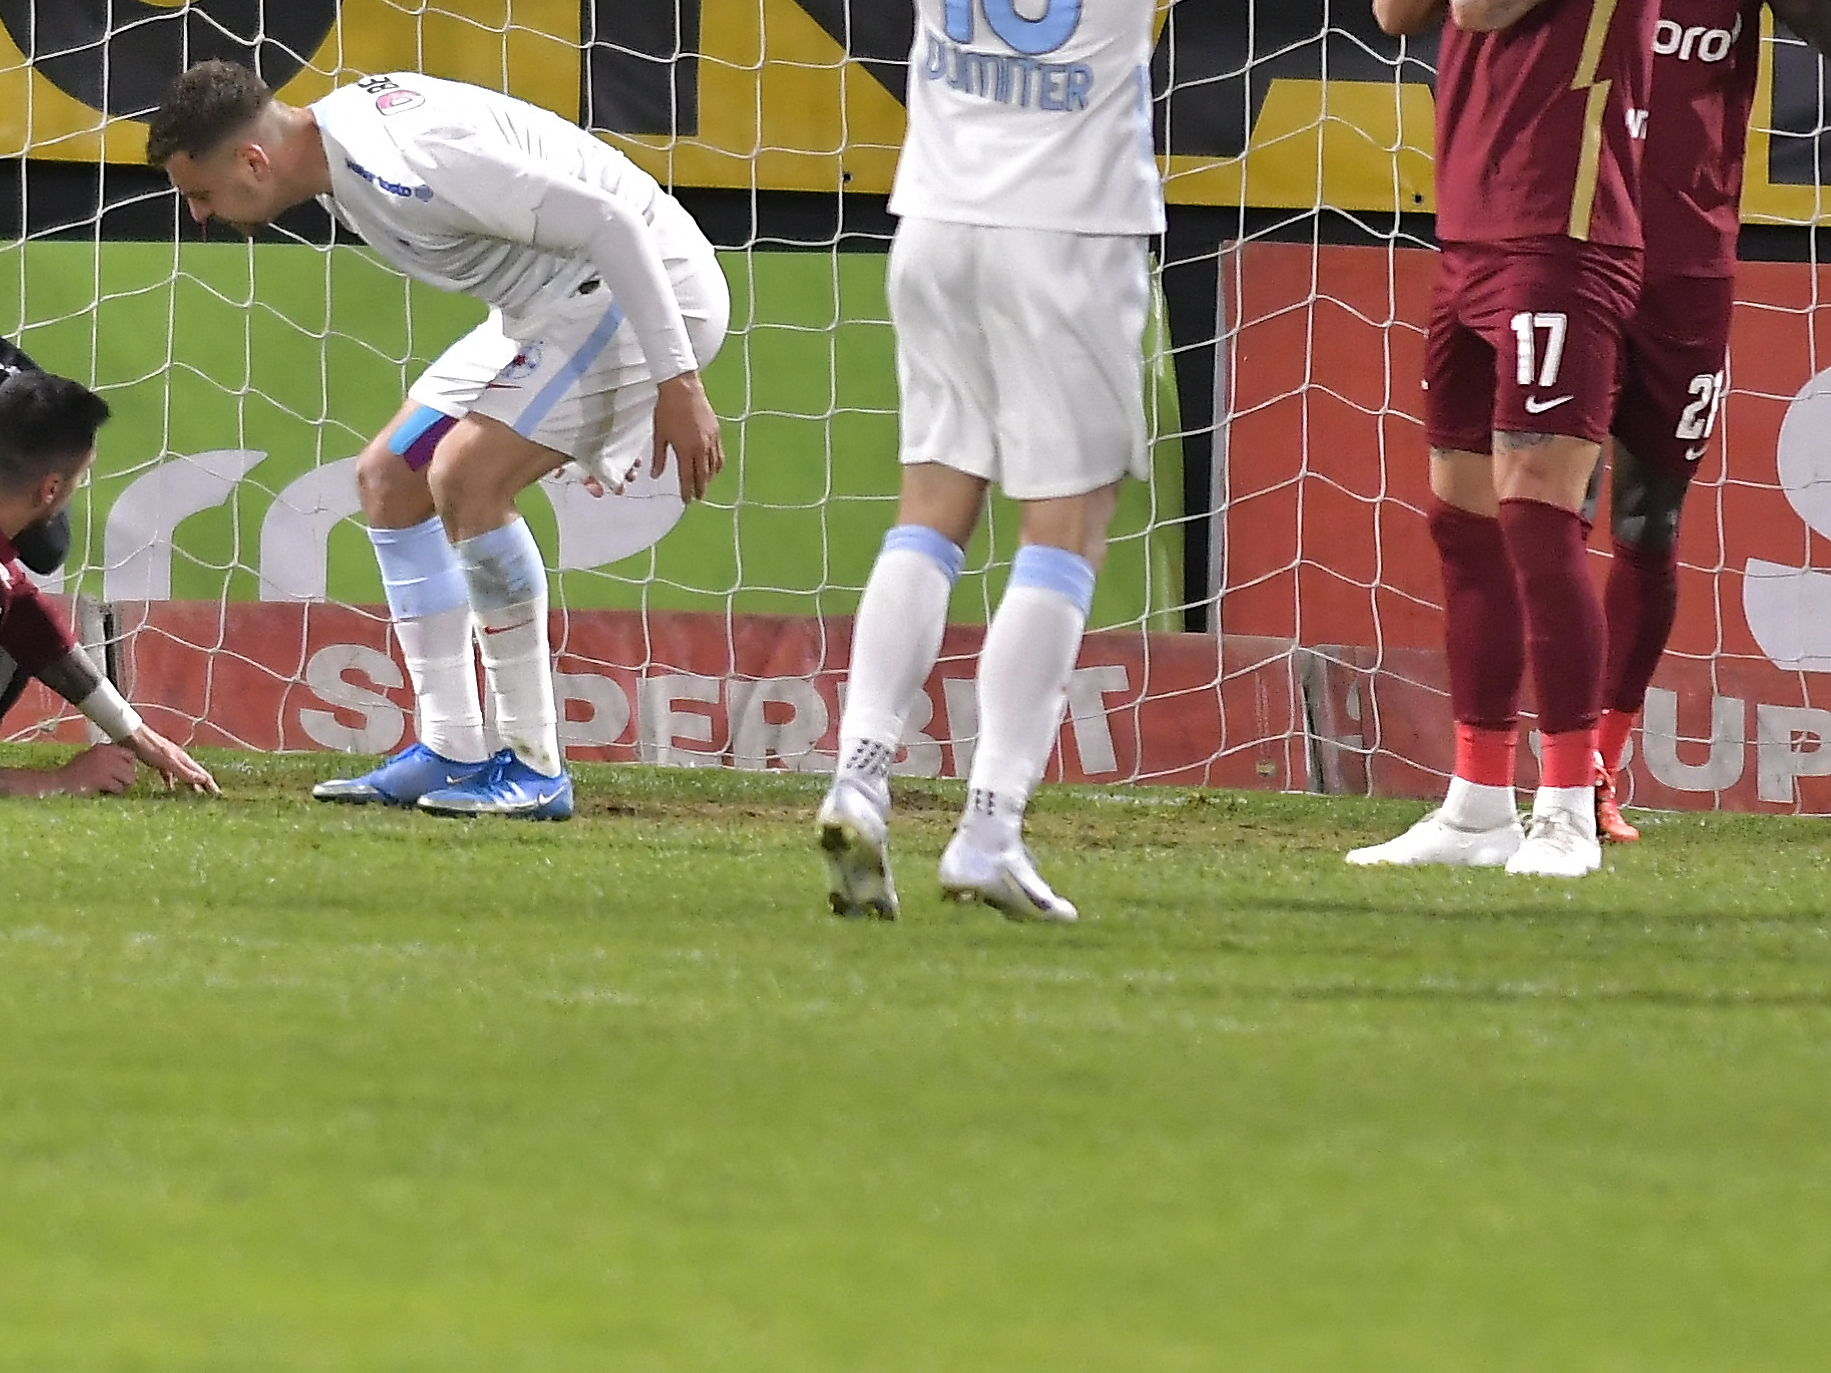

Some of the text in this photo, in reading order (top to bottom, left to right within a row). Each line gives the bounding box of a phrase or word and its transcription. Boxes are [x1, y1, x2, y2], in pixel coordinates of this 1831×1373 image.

[1511, 311, 1567, 387] 17
[1675, 369, 1725, 440] 21
[299, 644, 1131, 776] SPERBT
[1617, 686, 1831, 804] UP
